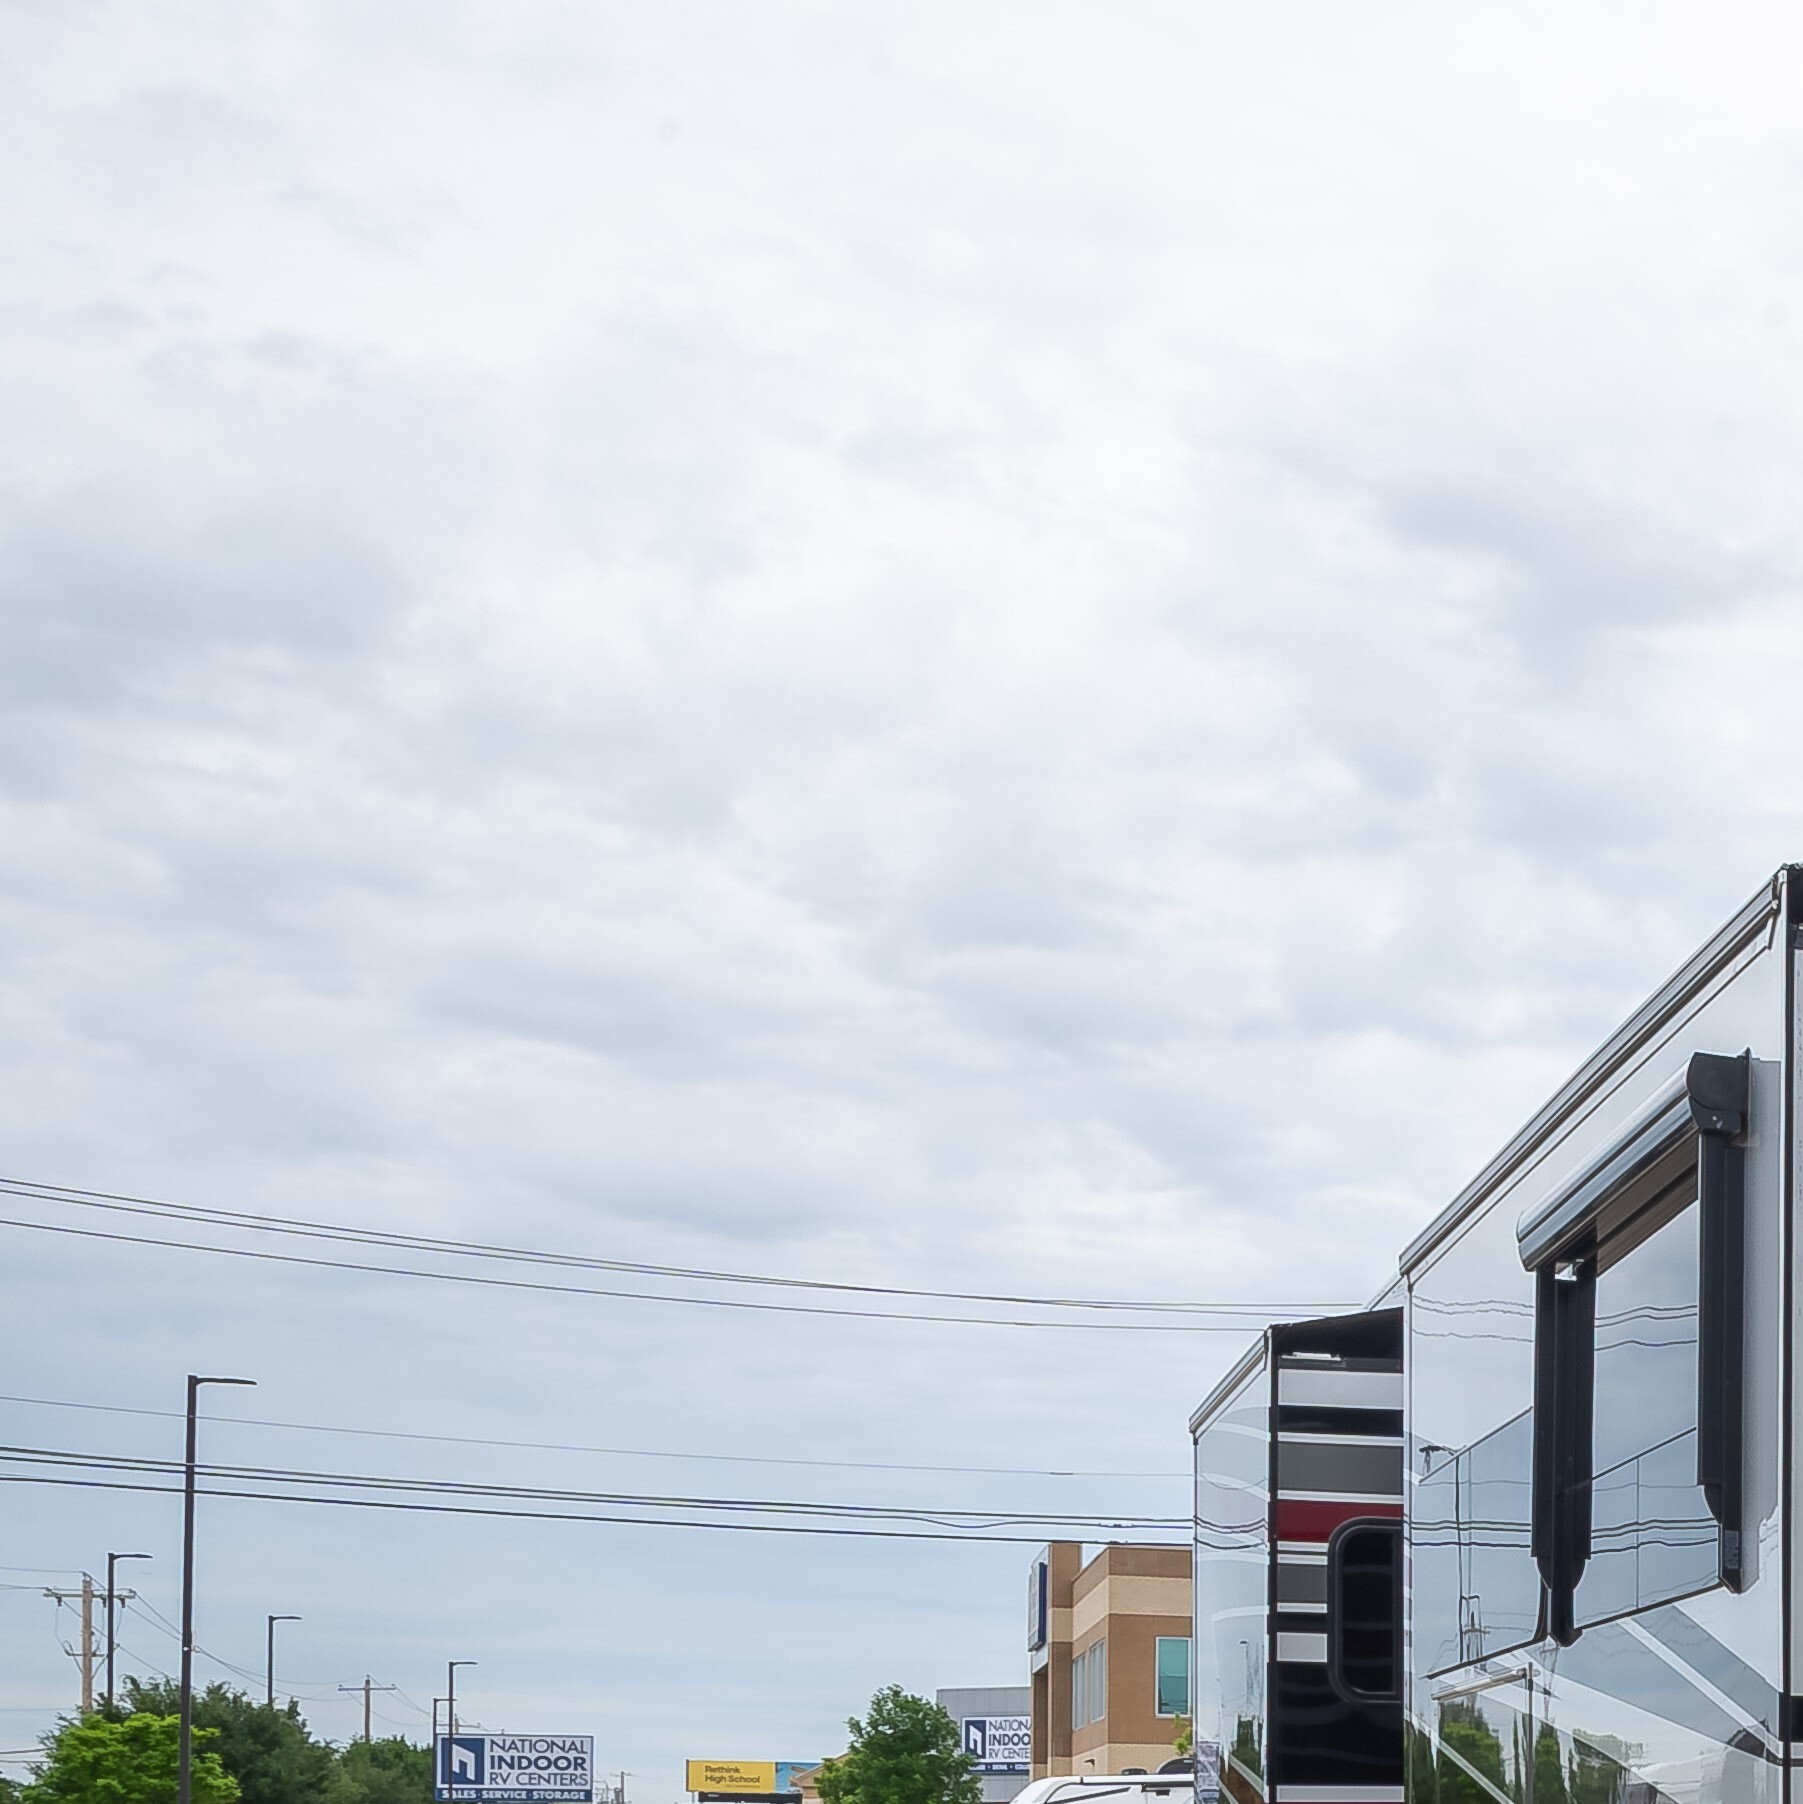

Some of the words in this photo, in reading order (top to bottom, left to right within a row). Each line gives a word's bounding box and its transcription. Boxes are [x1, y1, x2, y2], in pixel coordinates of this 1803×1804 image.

[489, 1739, 588, 1754] NATIONAL
[989, 1748, 1000, 1759] RV
[490, 1755, 587, 1771] INDOOR
[704, 1765, 741, 1773] Rethink
[489, 1772, 511, 1785] RV
[516, 1772, 588, 1786] CENTERS
[704, 1775, 727, 1784] High
[728, 1775, 761, 1783] School
[482, 1790, 527, 1799] SERVICE
[533, 1790, 585, 1800] STORAGE
